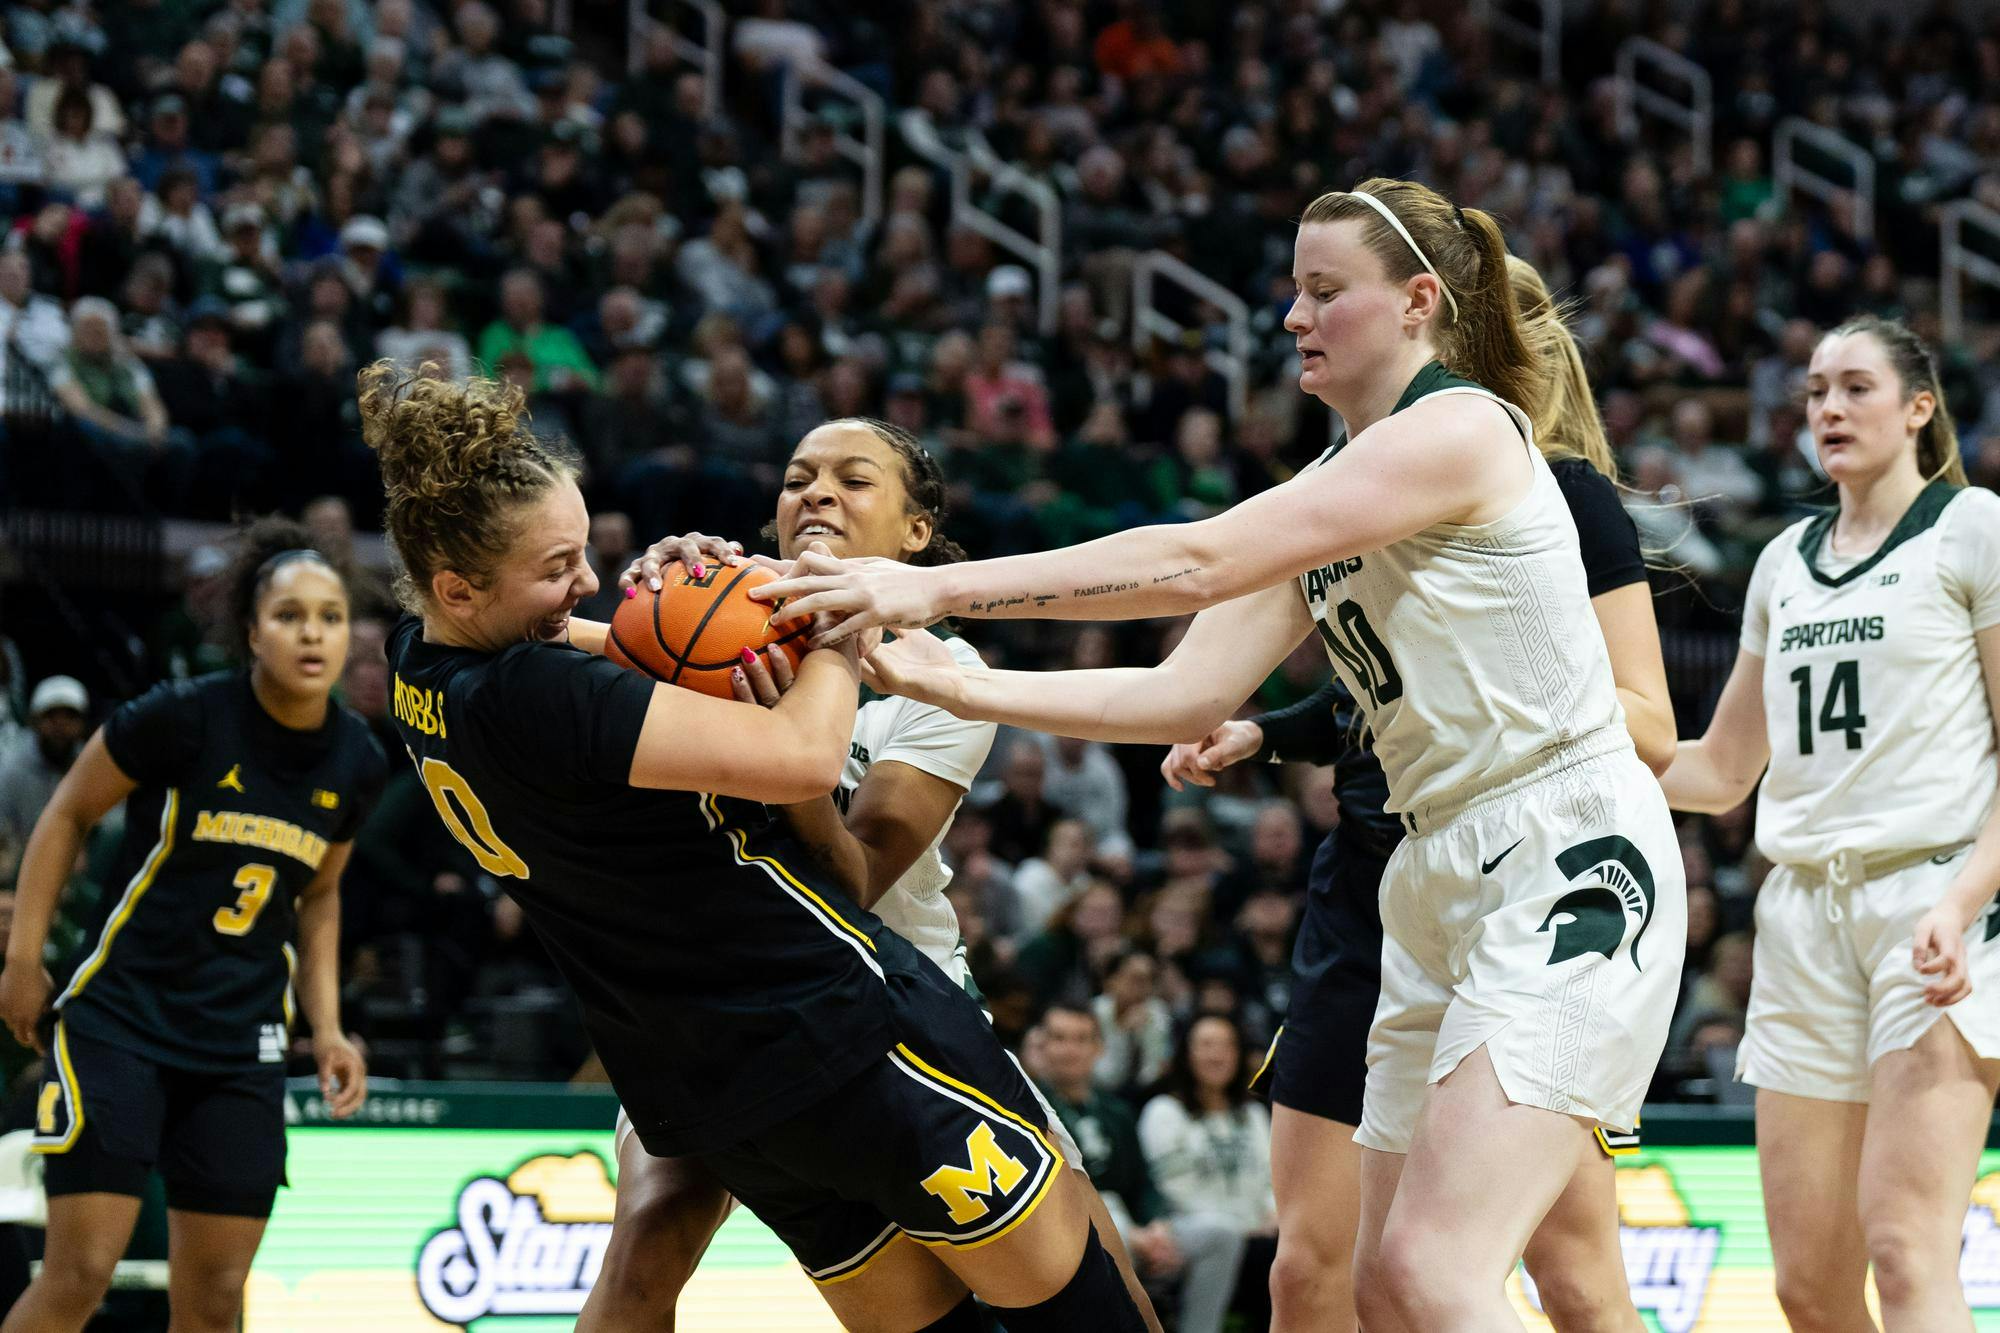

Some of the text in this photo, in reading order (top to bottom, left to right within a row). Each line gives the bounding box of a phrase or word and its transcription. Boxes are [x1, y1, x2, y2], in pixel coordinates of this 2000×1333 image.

[1073, 581, 1140, 598] FAMILY 40 16
[1316, 598, 1404, 711] 40
[1779, 616, 1884, 653] SPARTANS
[1790, 659, 1867, 756] 14
[212, 862, 279, 937] 3
[919, 1119, 1029, 1226] M
